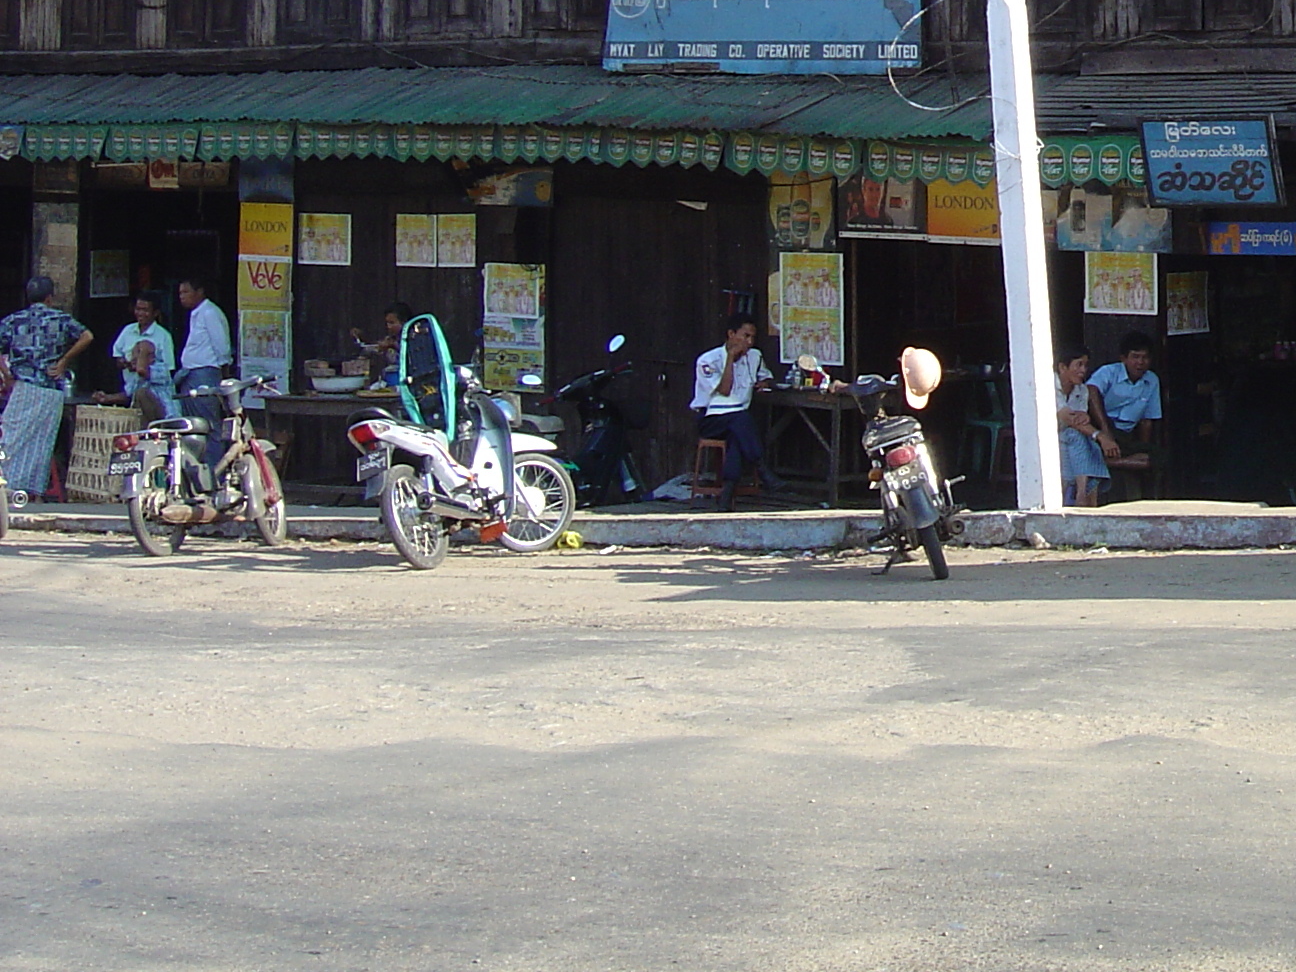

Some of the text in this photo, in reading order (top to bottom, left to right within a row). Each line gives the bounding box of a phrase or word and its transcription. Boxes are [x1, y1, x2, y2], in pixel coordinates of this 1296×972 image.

[610, 44, 635, 57] MYAT
[648, 44, 664, 57] LAY
[677, 43, 717, 58] TRADING
[728, 44, 746, 58] CO.
[757, 44, 811, 59] OPERATIVE
[823, 44, 866, 59] SOCIETY
[934, 194, 994, 211] LONDON
[245, 220, 288, 233] LONDON
[247, 261, 282, 290] VeVe
